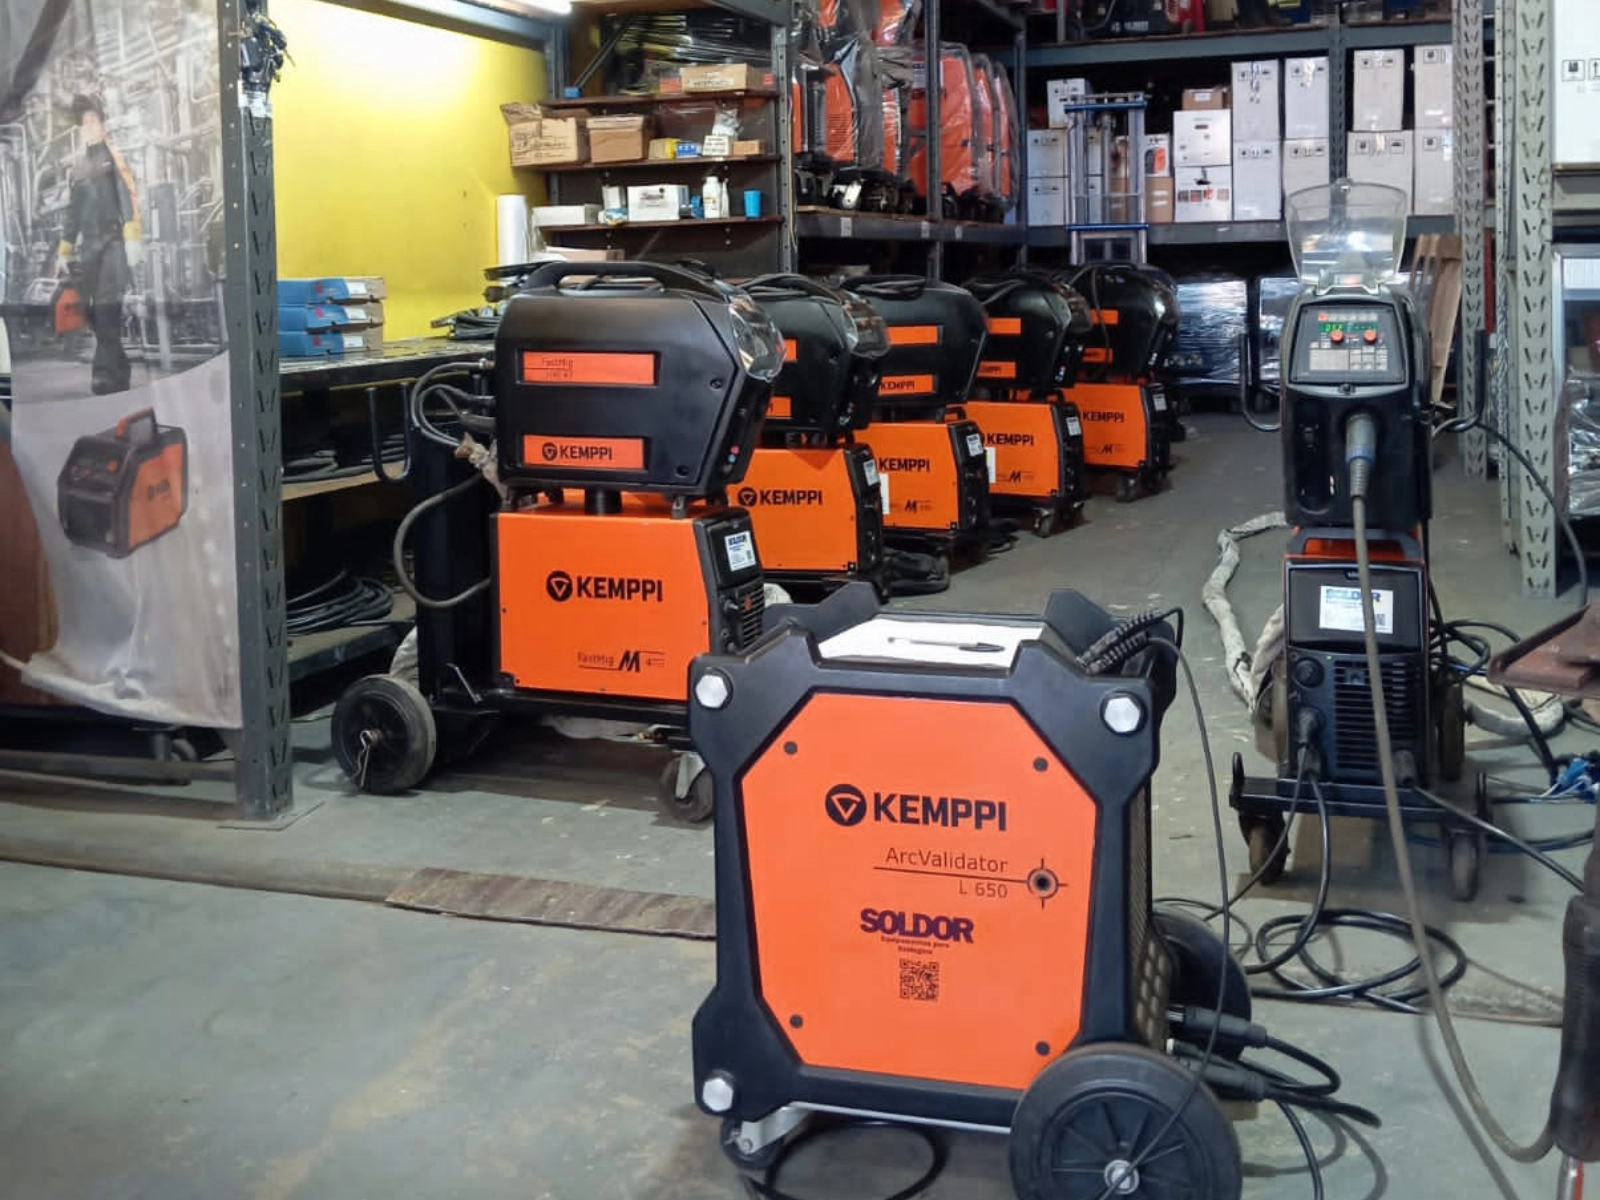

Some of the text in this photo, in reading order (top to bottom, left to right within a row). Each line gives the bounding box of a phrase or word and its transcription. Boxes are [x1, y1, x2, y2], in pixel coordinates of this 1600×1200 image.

[1082, 411, 1125, 423] KEMPPI
[986, 433, 1034, 446] KEMPPI
[559, 445, 612, 460] KEMPPI
[879, 458, 930, 472] KEMPPI
[759, 489, 823, 505] KEMPPI
[577, 576, 663, 602] KEMPPI
[873, 792, 1007, 832] KEMPPI
[885, 847, 1008, 873] ArcValidator
[959, 880, 1008, 899] L 650
[860, 907, 974, 943] SOLDOR
